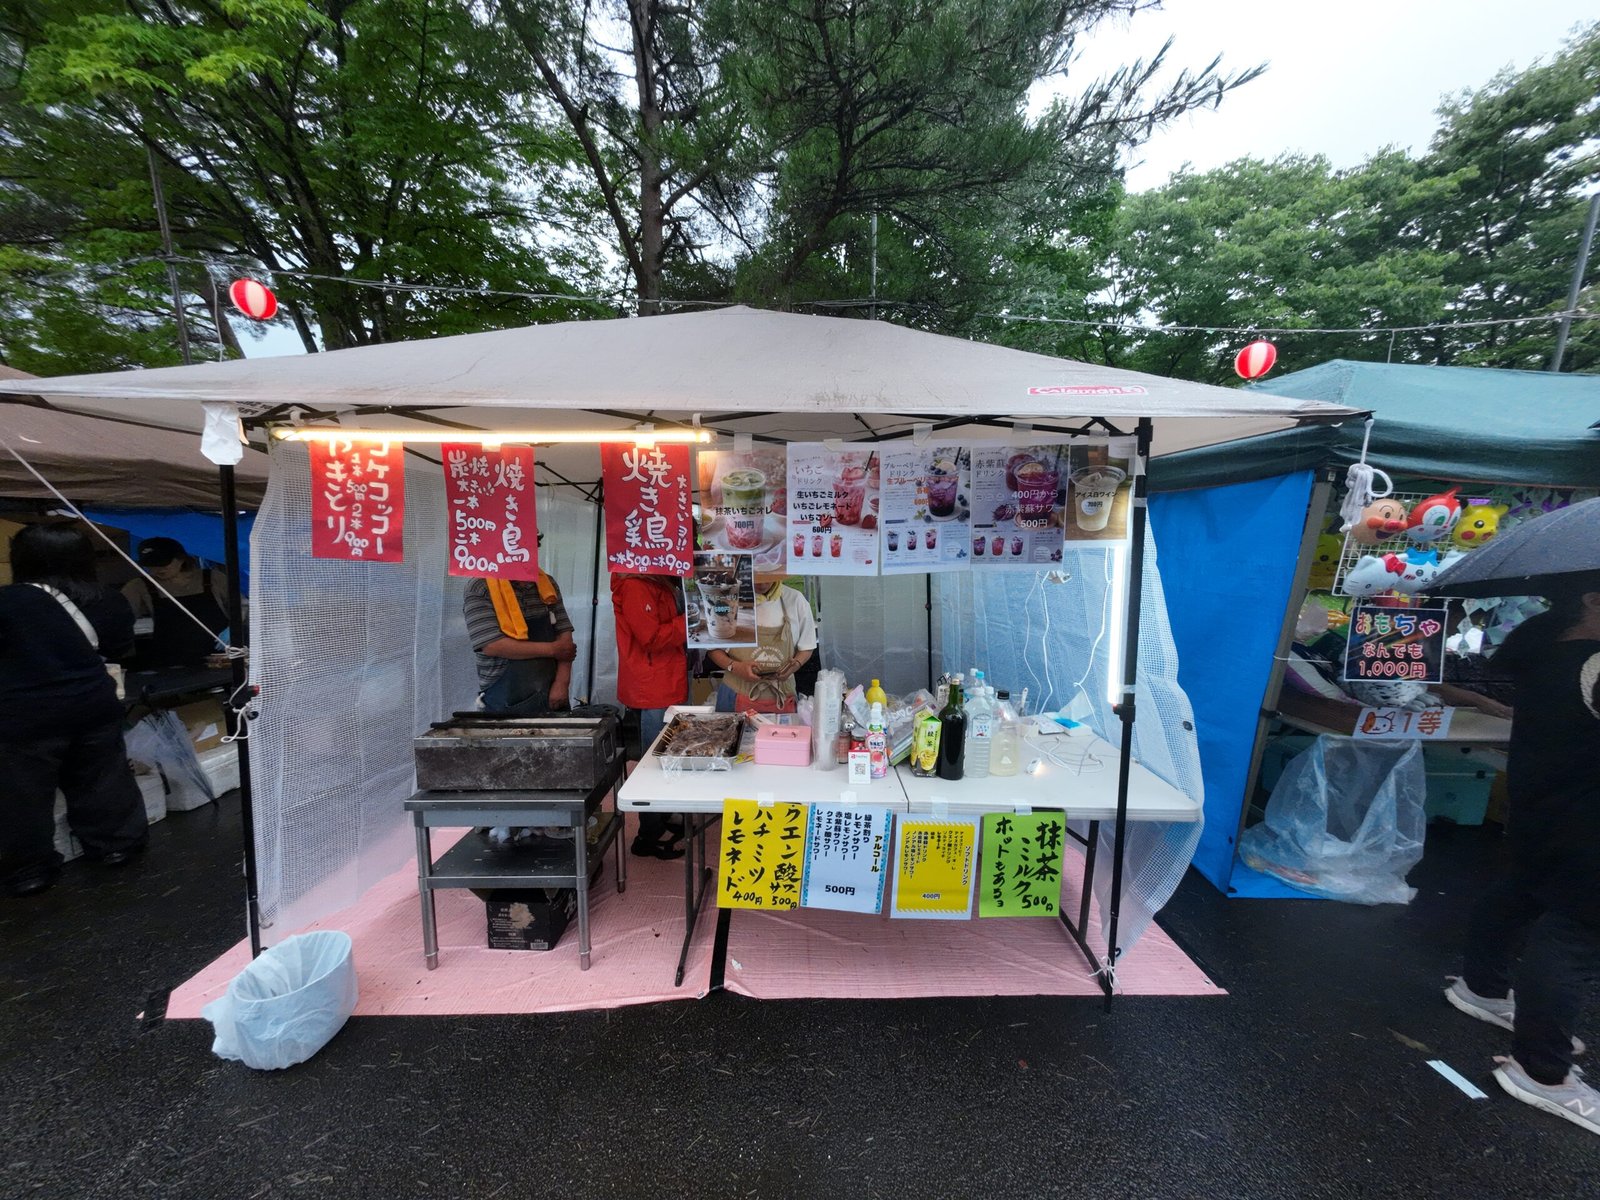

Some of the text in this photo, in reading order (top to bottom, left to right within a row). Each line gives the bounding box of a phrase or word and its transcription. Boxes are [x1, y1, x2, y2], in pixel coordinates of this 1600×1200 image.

[448, 450, 490, 478] 炭焼
[795, 465, 824, 475] いちご
[976, 469, 1005, 478] ドリンク
[324, 439, 352, 543] やきとり
[797, 478, 822, 486] ドリンク
[797, 491, 849, 499] 生いちごミルク
[1012, 489, 1058, 499] 400円から
[494, 456, 530, 563] 焼き鳥
[715, 506, 773, 515] 抹茶いちごオレ
[793, 502, 852, 510] いちごレモネード
[455, 509, 496, 531] 500円
[1020, 518, 1048, 528] 500円
[454, 545, 499, 572] 900円
[1356, 612, 1441, 637] おもちゃ
[1363, 643, 1424, 659] なんでも
[1359, 661, 1426, 678] 1,000円
[813, 809, 823, 860] レモネードサワー
[841, 812, 852, 861] 塩レモンサワー
[851, 813, 862, 860] レモンサワー
[725, 811, 746, 892] レモネード
[749, 809, 774, 885] ハチミツ
[871, 835, 883, 873] アルコール
[1028, 820, 1062, 882] 抹茶
[962, 846, 971, 886] ソフトドリンク
[1012, 837, 1034, 896] ミルク
[732, 890, 763, 906] 400円
[825, 885, 855, 896] 500円
[771, 896, 797, 909] 500円
[1022, 894, 1053, 912] 500円
